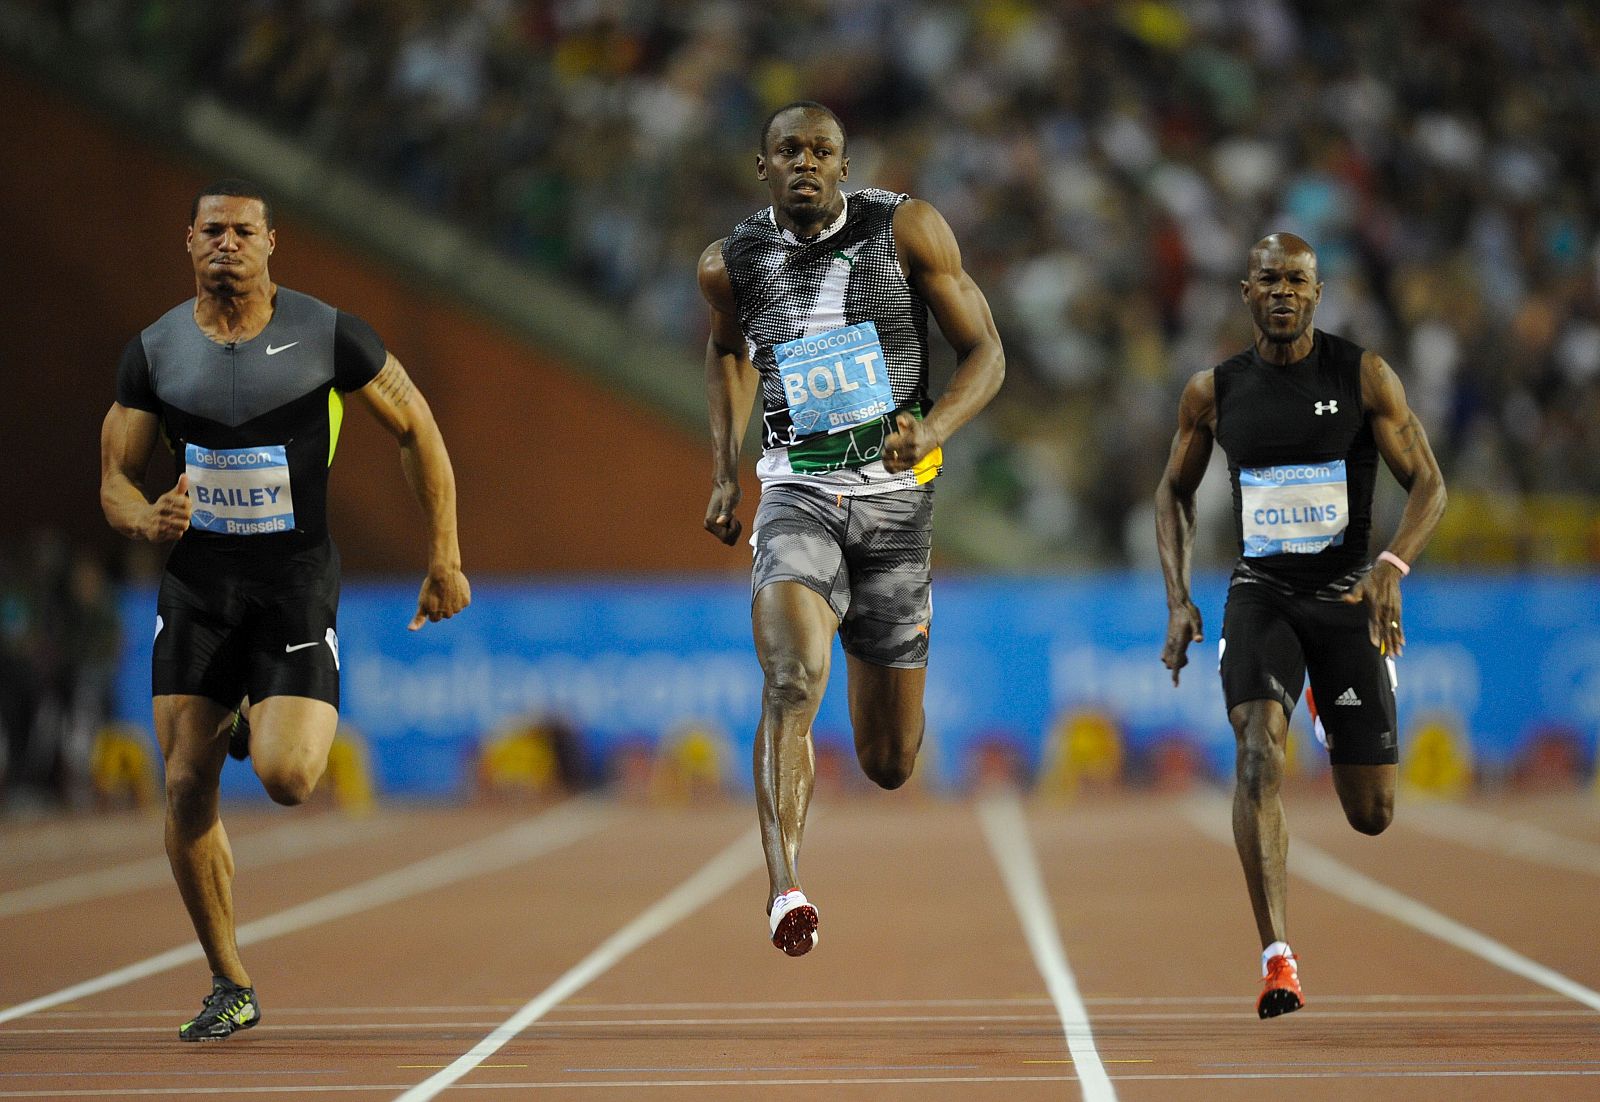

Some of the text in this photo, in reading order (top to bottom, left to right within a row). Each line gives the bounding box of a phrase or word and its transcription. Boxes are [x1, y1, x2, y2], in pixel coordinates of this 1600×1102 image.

[783, 330, 862, 358] belgacom
[783, 351, 879, 406] BOLT
[828, 400, 887, 426] Brussels
[195, 448, 272, 469] belgacom
[1253, 466, 1331, 484] belgacom
[196, 485, 281, 507] BAILEY
[226, 517, 286, 533] Brussels
[1254, 504, 1337, 526] COLLINS
